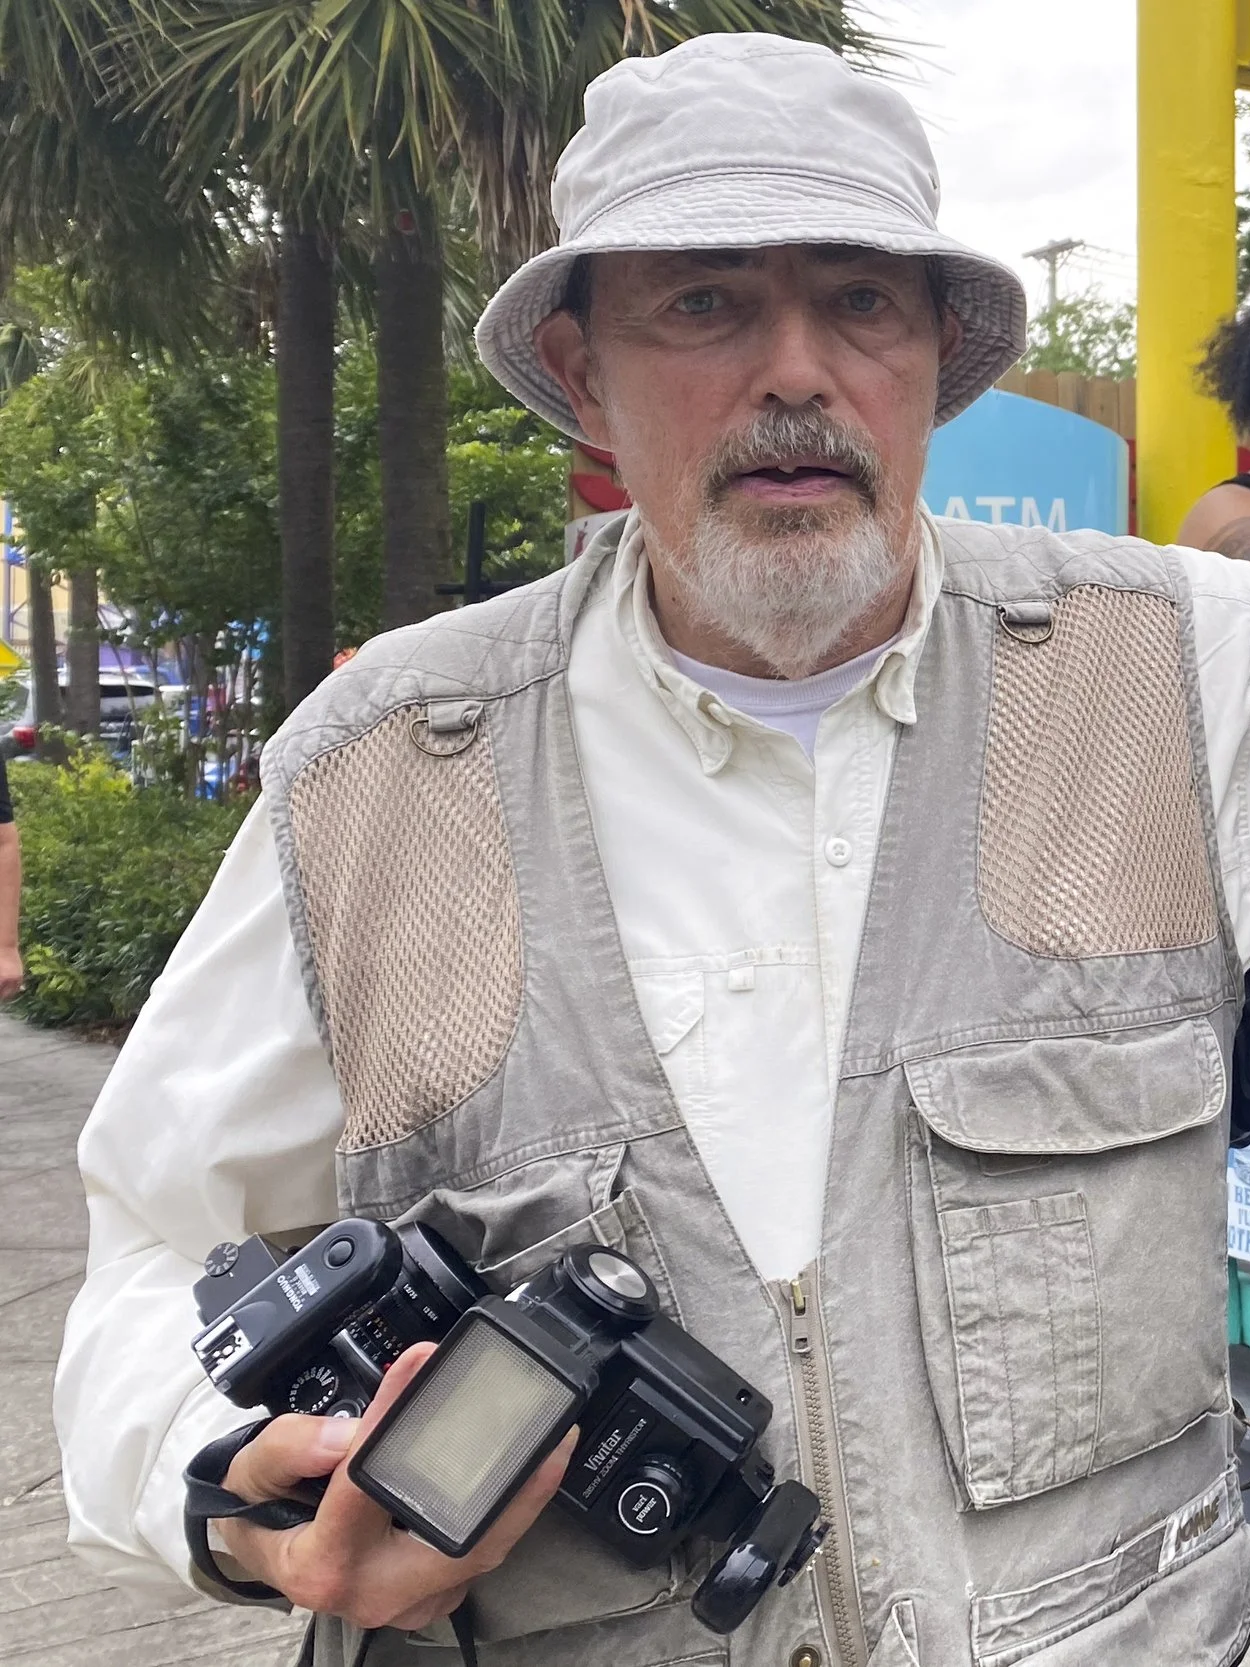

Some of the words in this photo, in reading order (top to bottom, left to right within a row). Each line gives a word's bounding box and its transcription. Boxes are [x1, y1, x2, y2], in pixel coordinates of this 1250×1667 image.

[944, 496, 1067, 532] ATM
[277, 1275, 304, 1313] YONGNUO
[583, 1429, 622, 1472] Vivitar
[599, 1454, 619, 1478] ZOOM
[615, 1418, 648, 1456] THYRISTOR
[632, 1494, 648, 1512] vari
[635, 1497, 657, 1523] power
